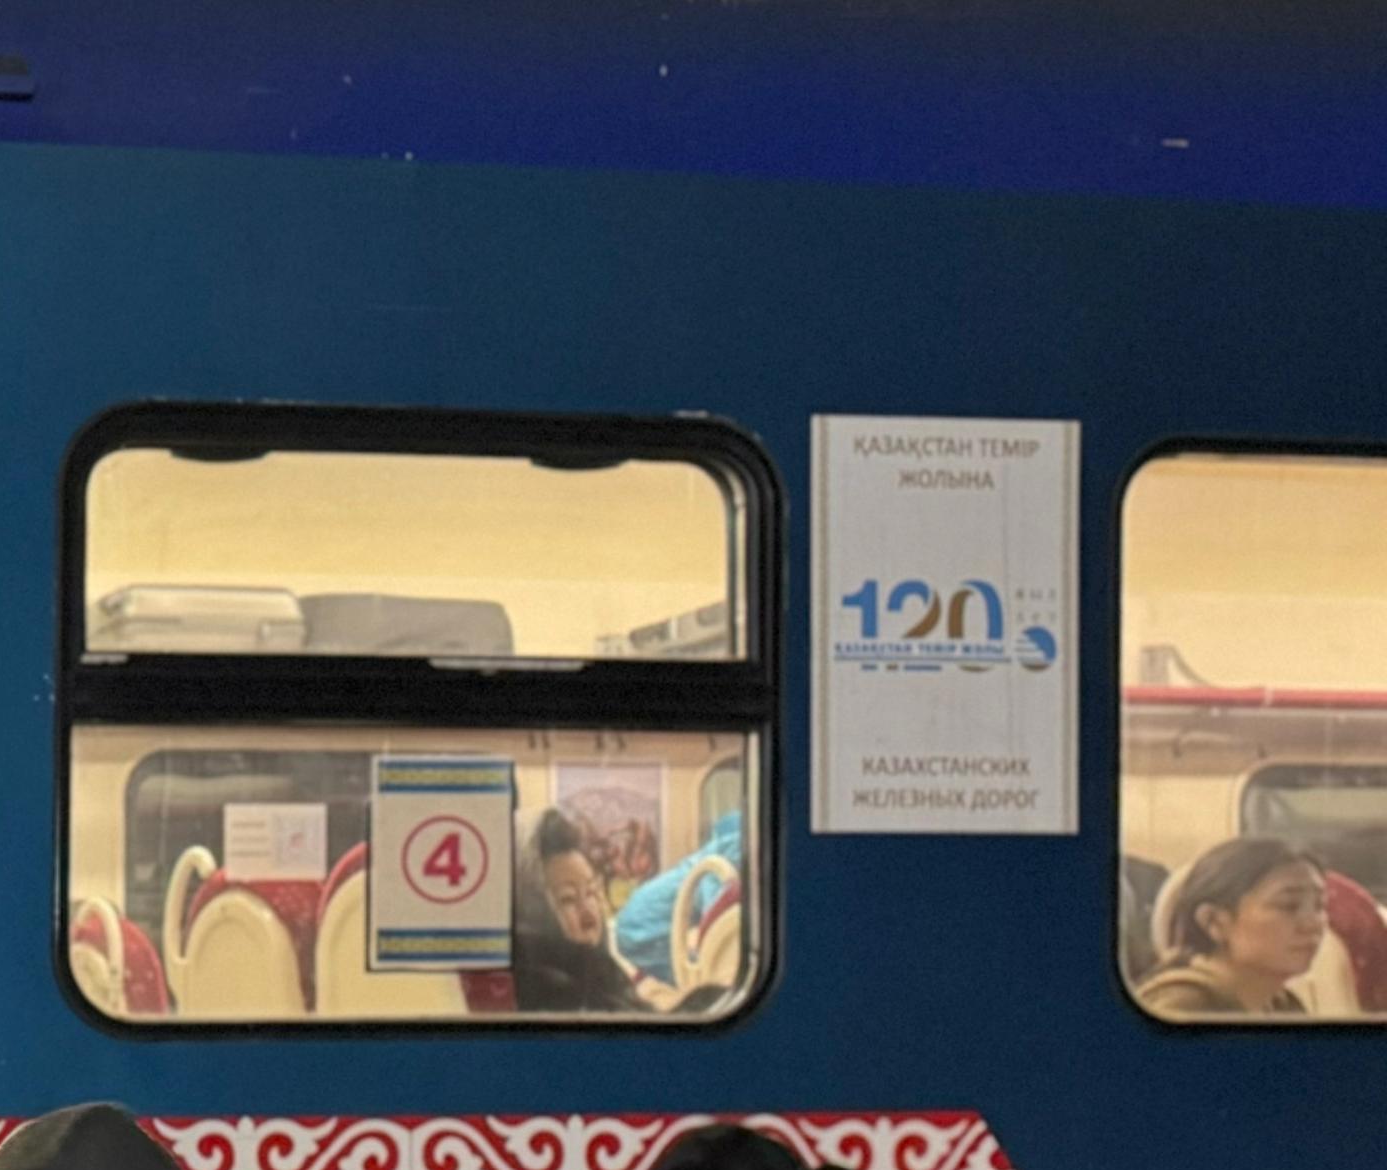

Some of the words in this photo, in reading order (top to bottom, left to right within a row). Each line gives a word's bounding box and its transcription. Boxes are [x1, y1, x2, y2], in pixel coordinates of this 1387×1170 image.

[854, 435, 973, 460] ҚАЗАҚСТАН
[979, 437, 1040, 458] ТЕМІР
[898, 468, 995, 490] ЖОЛЫНА
[842, 579, 1003, 640] 120
[862, 757, 1031, 776] КАЗАХСТАНСКИХ
[852, 789, 965, 809] ЖЕЛЕЗНЫХ
[970, 789, 1039, 810] ДОРОГ
[423, 832, 466, 886] 4
